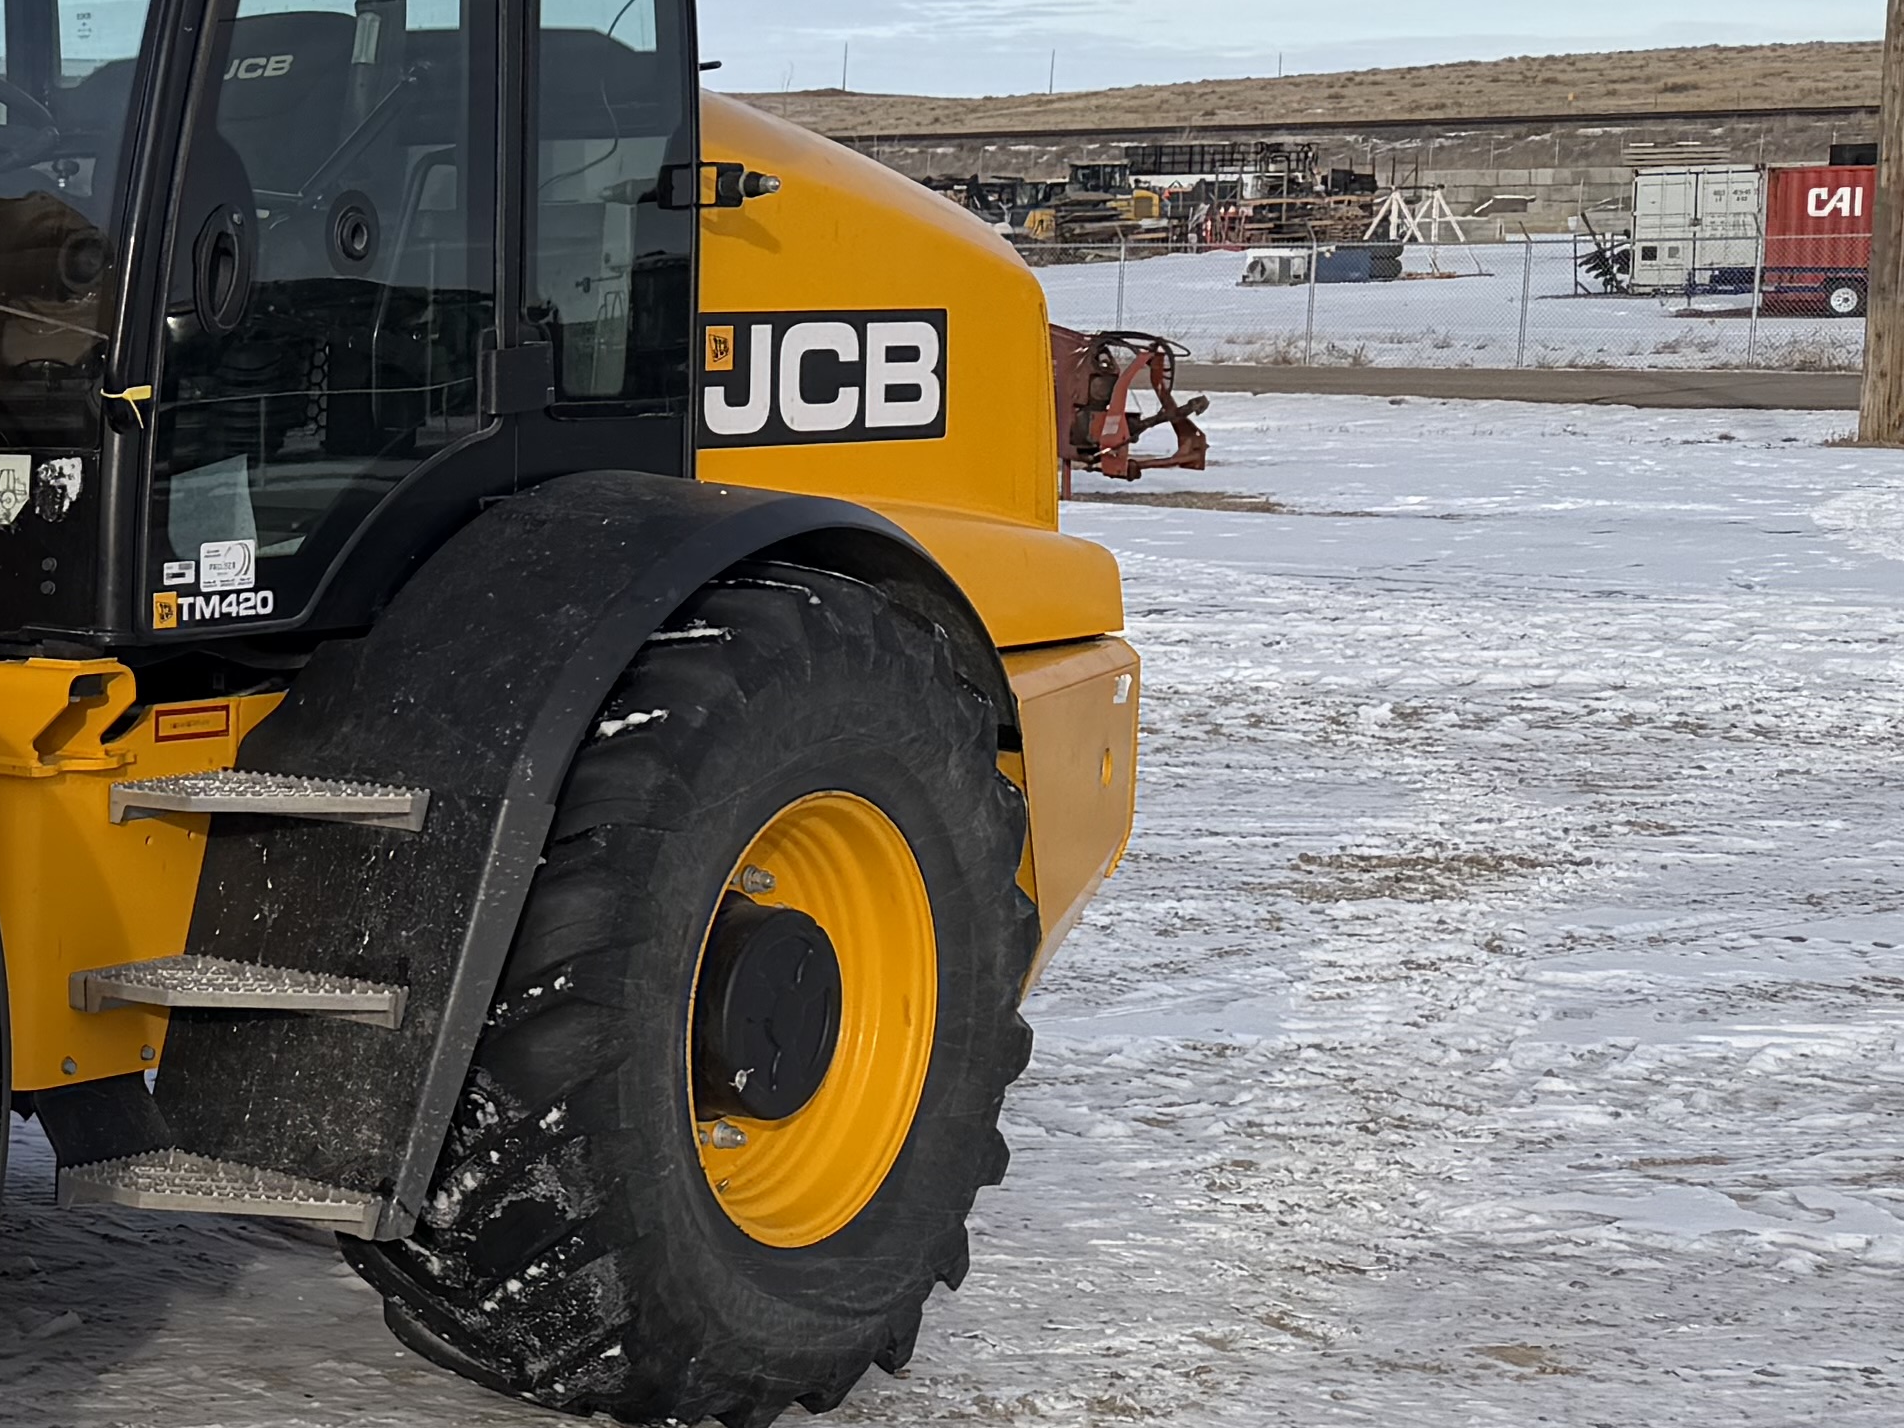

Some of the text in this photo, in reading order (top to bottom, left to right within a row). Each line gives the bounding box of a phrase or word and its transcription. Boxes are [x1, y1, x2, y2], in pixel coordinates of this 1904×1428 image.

[223, 54, 294, 81] JCB
[1807, 186, 1864, 217] CAI
[703, 321, 941, 435] JCB
[177, 589, 274, 621] TM420
